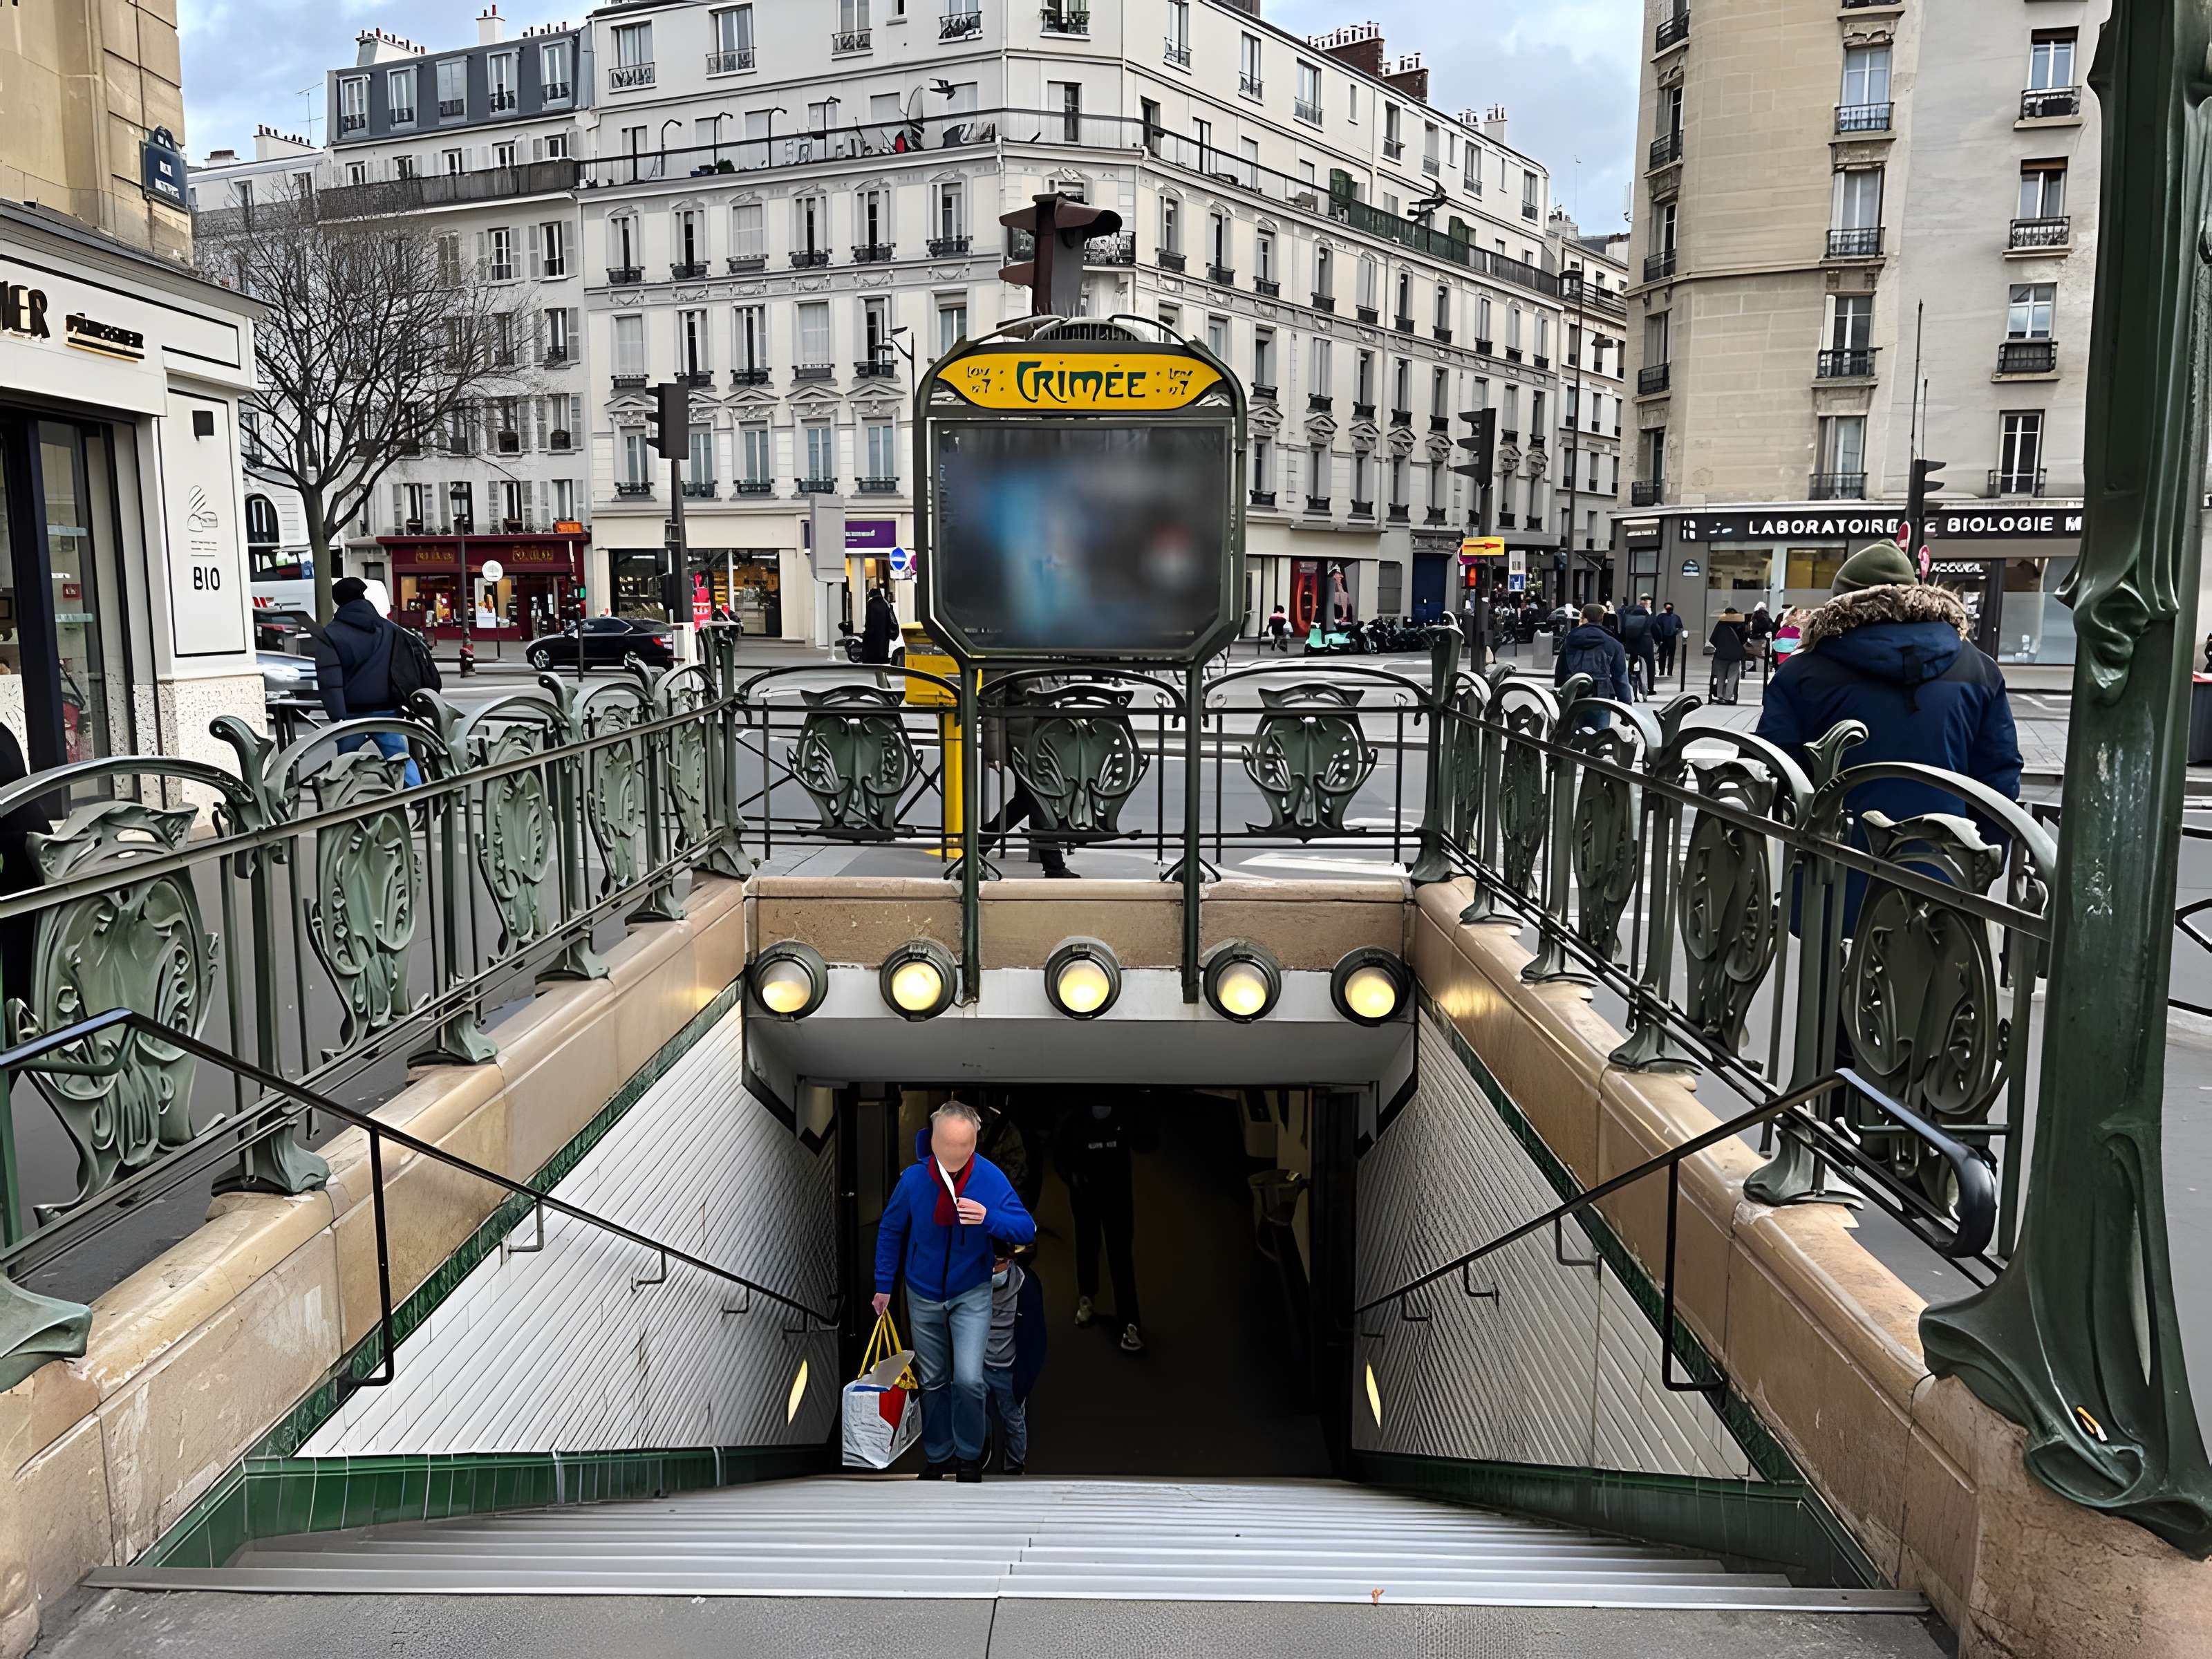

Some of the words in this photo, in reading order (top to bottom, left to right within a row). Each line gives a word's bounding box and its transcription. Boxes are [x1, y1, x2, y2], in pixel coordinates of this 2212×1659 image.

[1749, 519, 1899, 534] LABORATOIRE
[1947, 516, 2054, 532] BIOLOGIE
[194, 567, 220, 590] BIO
